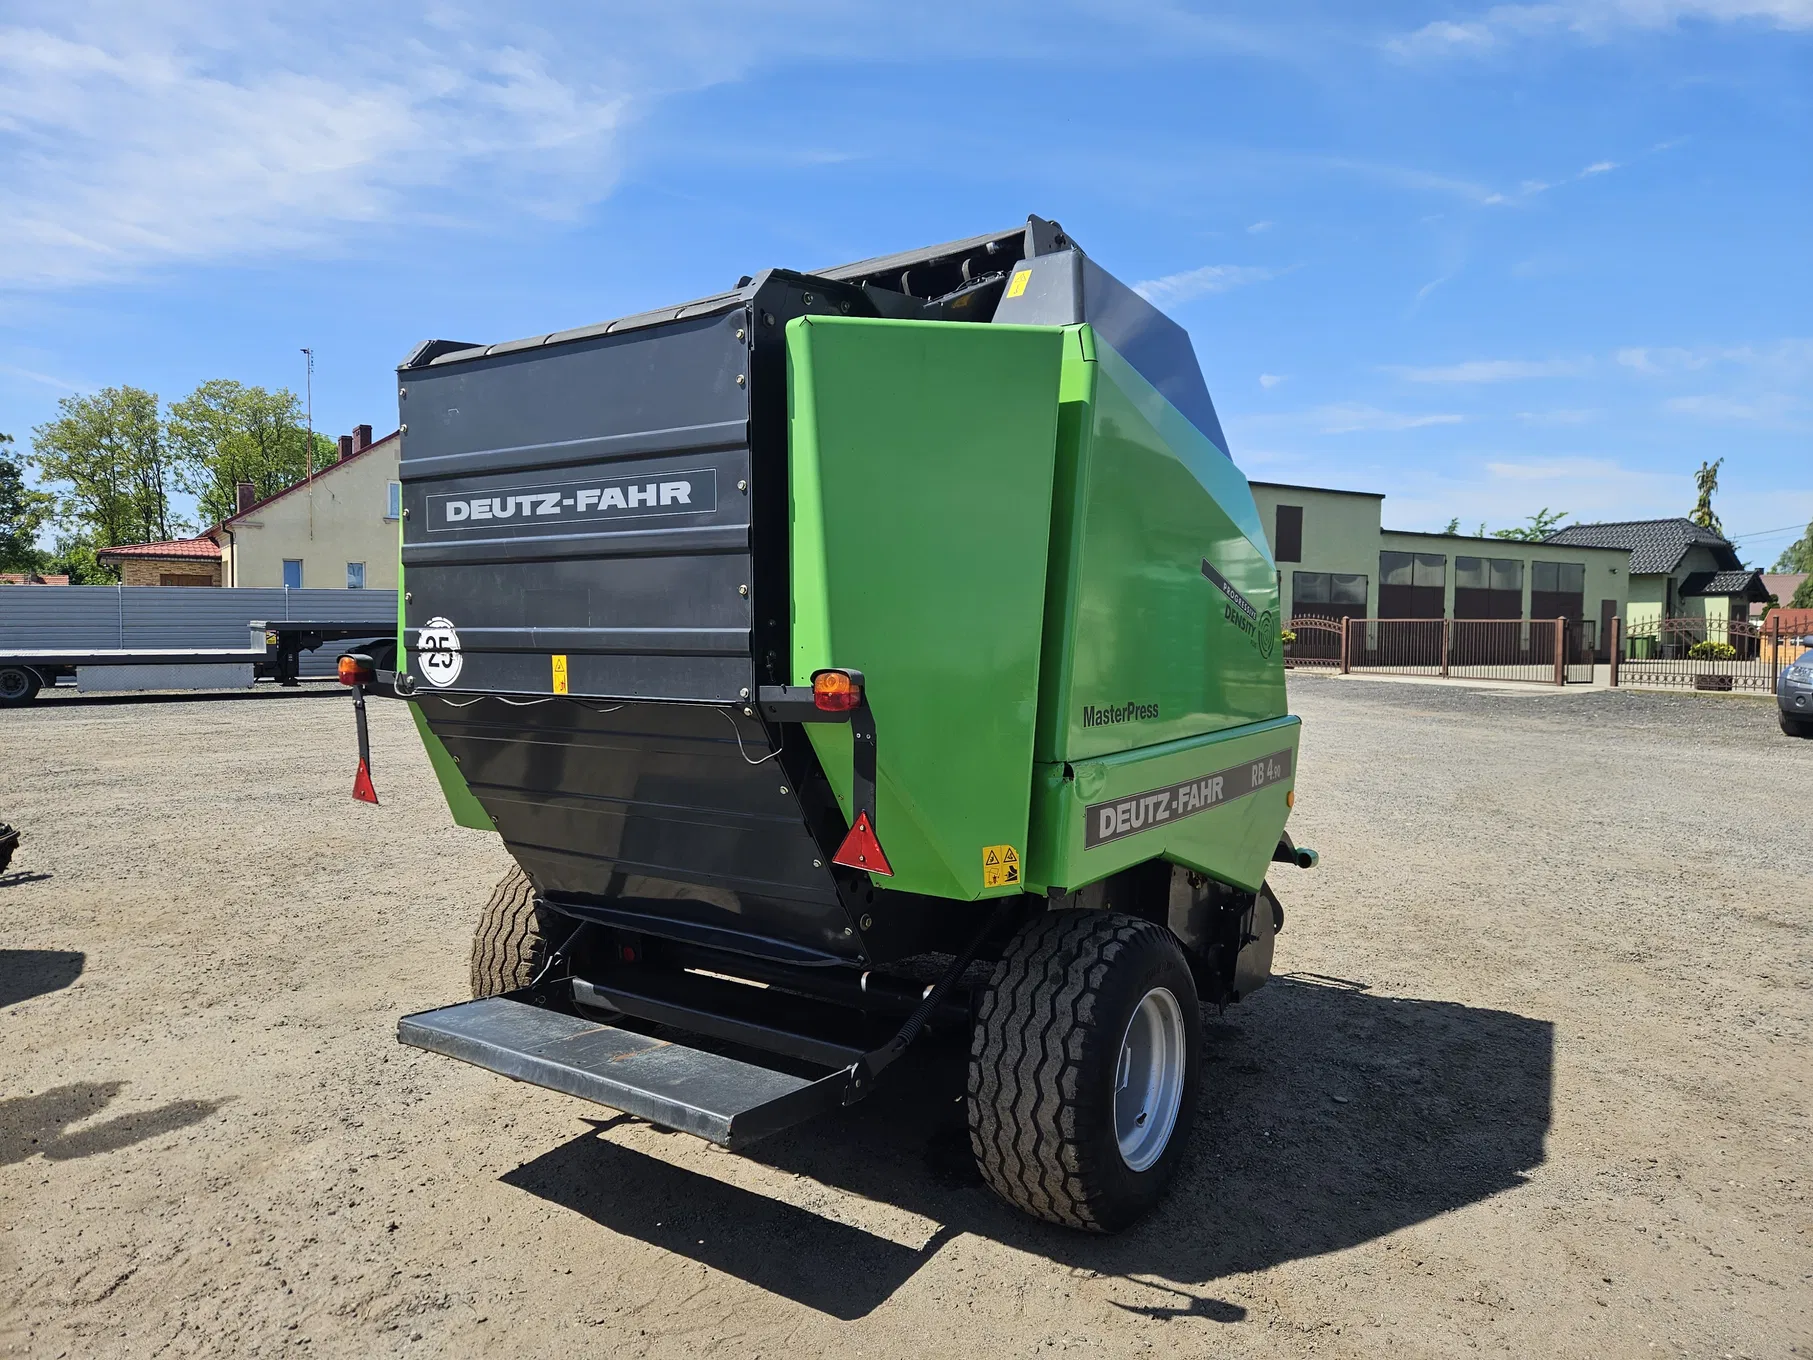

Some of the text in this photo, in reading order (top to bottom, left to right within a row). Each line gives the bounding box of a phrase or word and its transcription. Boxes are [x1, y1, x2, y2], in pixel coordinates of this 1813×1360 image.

[446, 481, 692, 522] DEUTZ-FAHR
[1223, 582, 1257, 620] PROGRESSIVE
[1224, 604, 1257, 637] DENSITY
[425, 635, 454, 669] 25
[1083, 701, 1159, 728] MasterPress
[1099, 776, 1224, 839] DEUTZ-FAHR
[1251, 762, 1265, 788] RB
